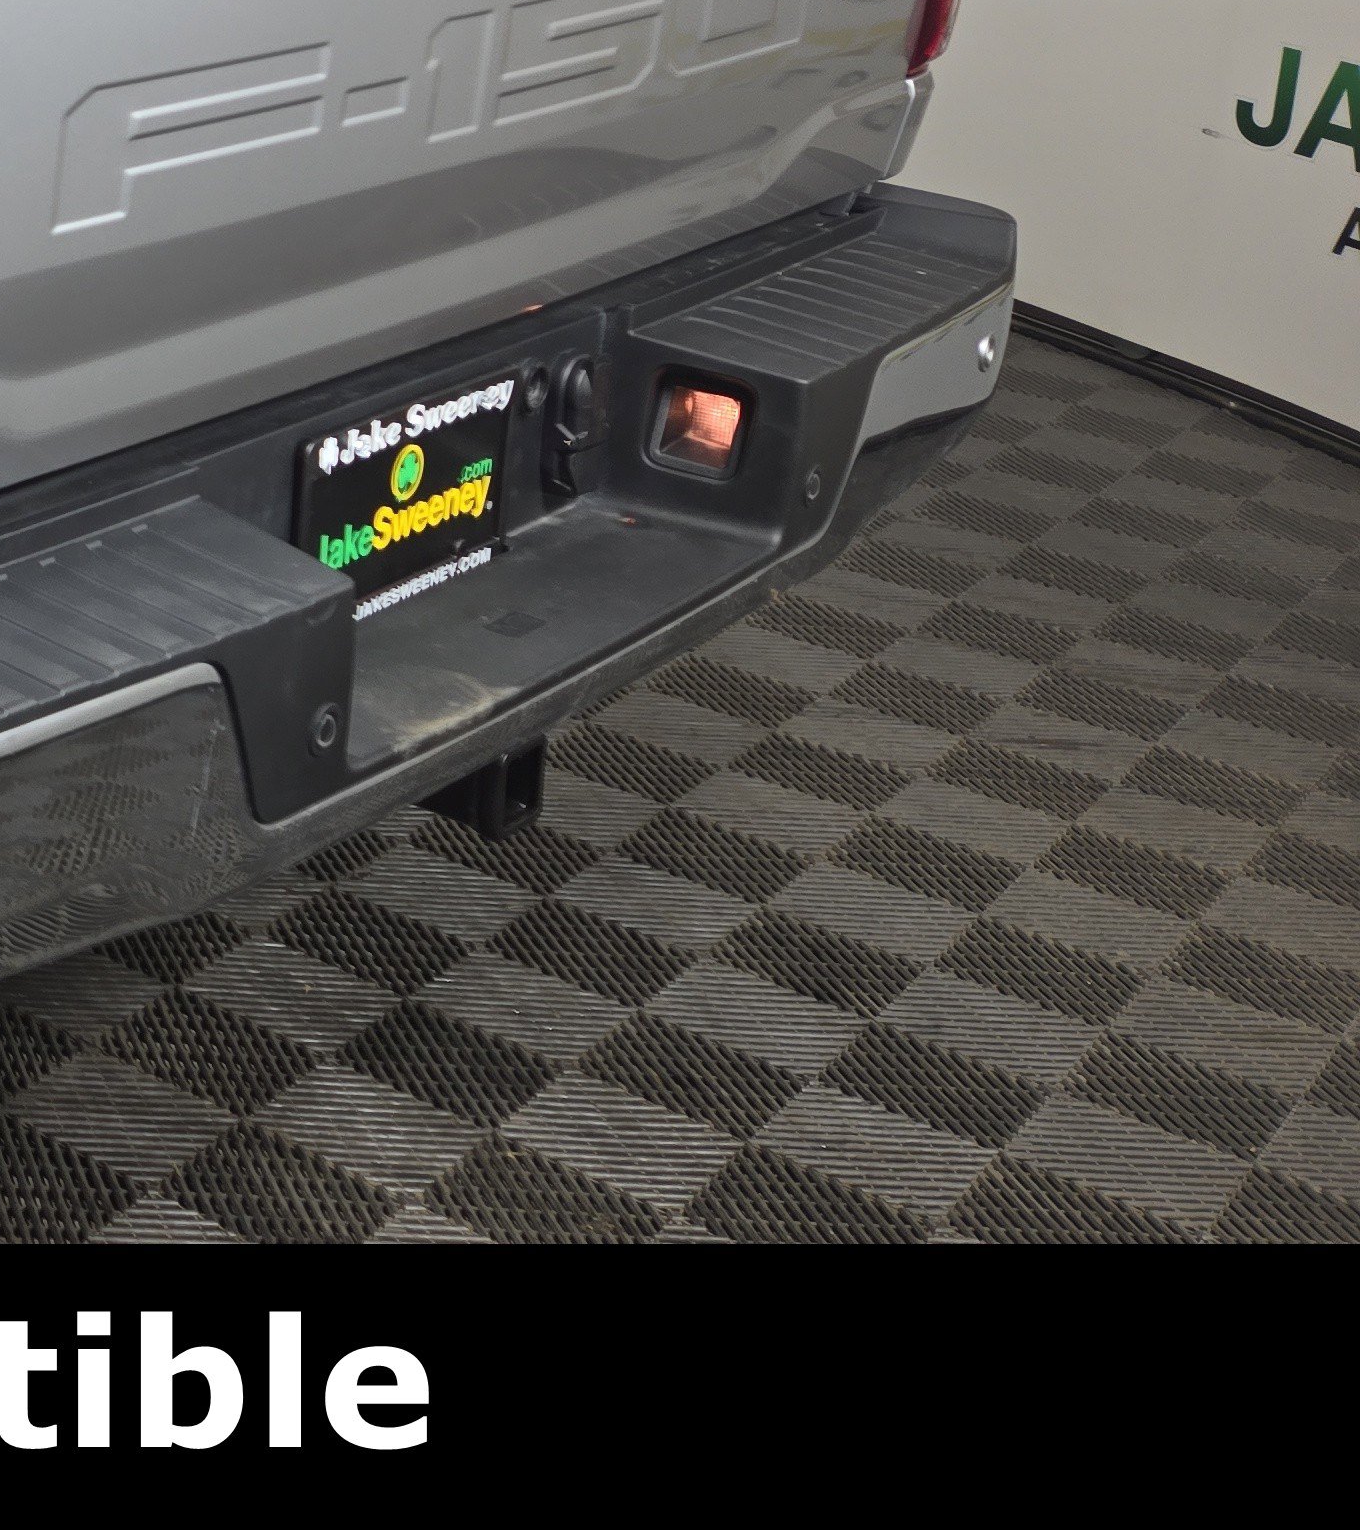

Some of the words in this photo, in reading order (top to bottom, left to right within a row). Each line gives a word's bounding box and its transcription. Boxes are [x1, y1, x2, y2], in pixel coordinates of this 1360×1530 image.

[1236, 46, 1360, 173] JA
[339, 420, 402, 465] Jake
[404, 379, 515, 438] Sweeney
[352, 547, 492, 621] JAKESWEENEY.COM
